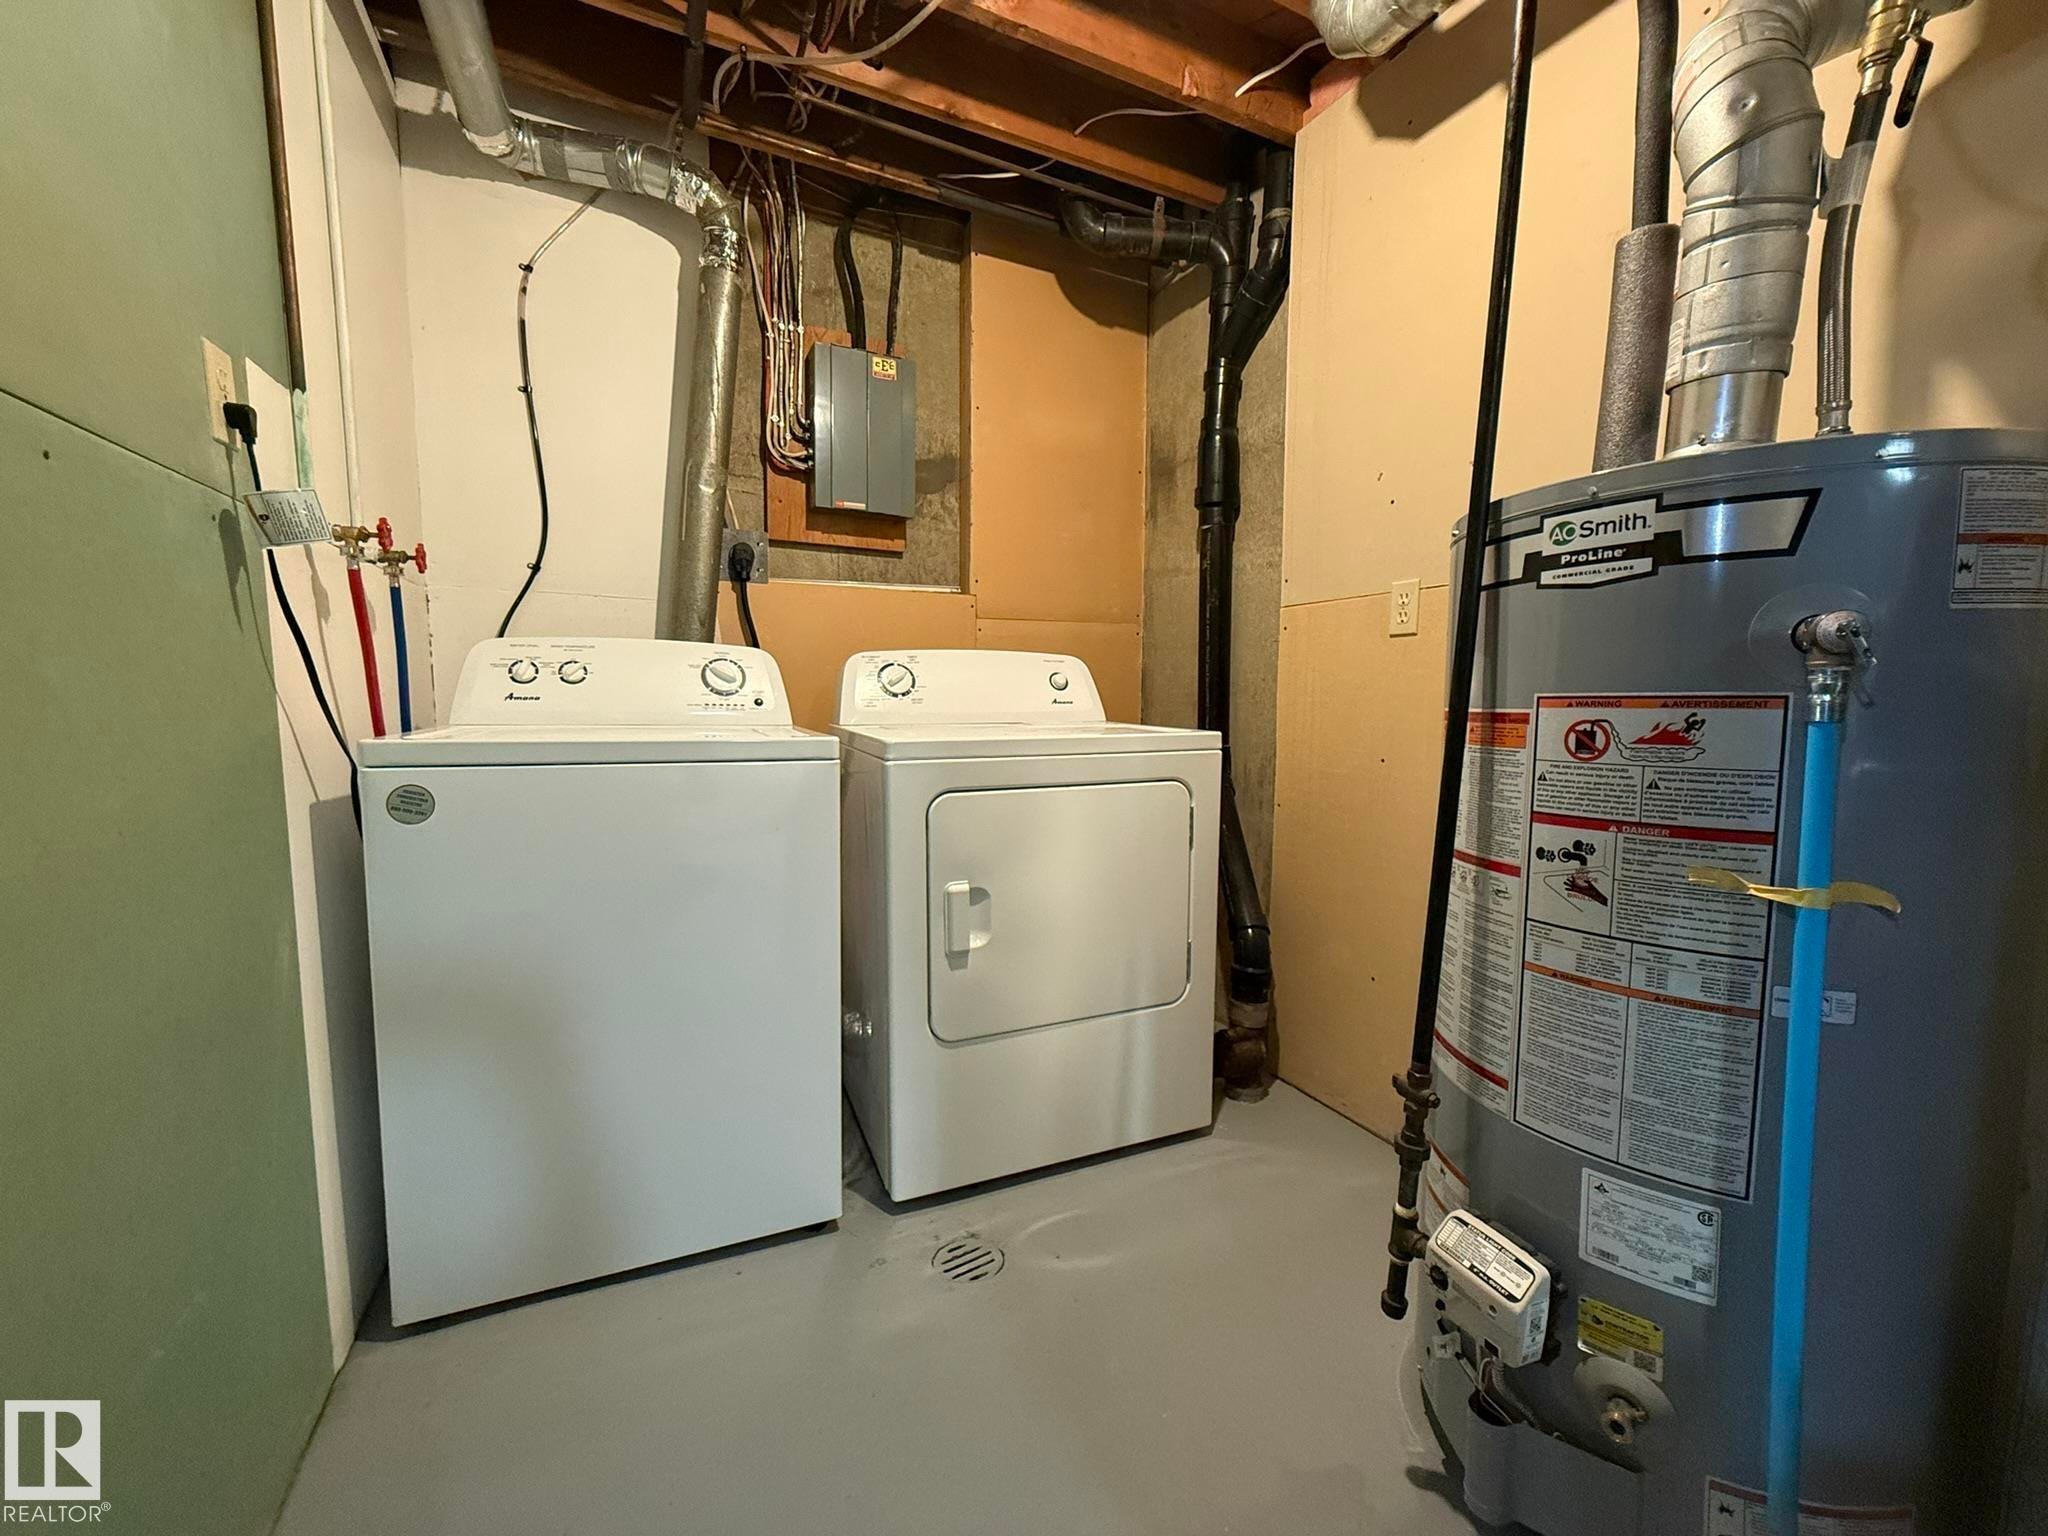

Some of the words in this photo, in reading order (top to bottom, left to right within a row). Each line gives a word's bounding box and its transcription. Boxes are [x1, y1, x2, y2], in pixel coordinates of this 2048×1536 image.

[1552, 568, 1602, 580] COMMERCIAL
[1605, 565, 1635, 573] GRADE
[504, 692, 541, 702] Amana
[1575, 699, 1622, 708] WARNING
[1671, 700, 1769, 709] AVERTISSEMENT
[1622, 825, 1671, 837] DANGER
[1486, 1236, 1501, 1250] LIGHT
[1501, 1248, 1516, 1260] CODE
